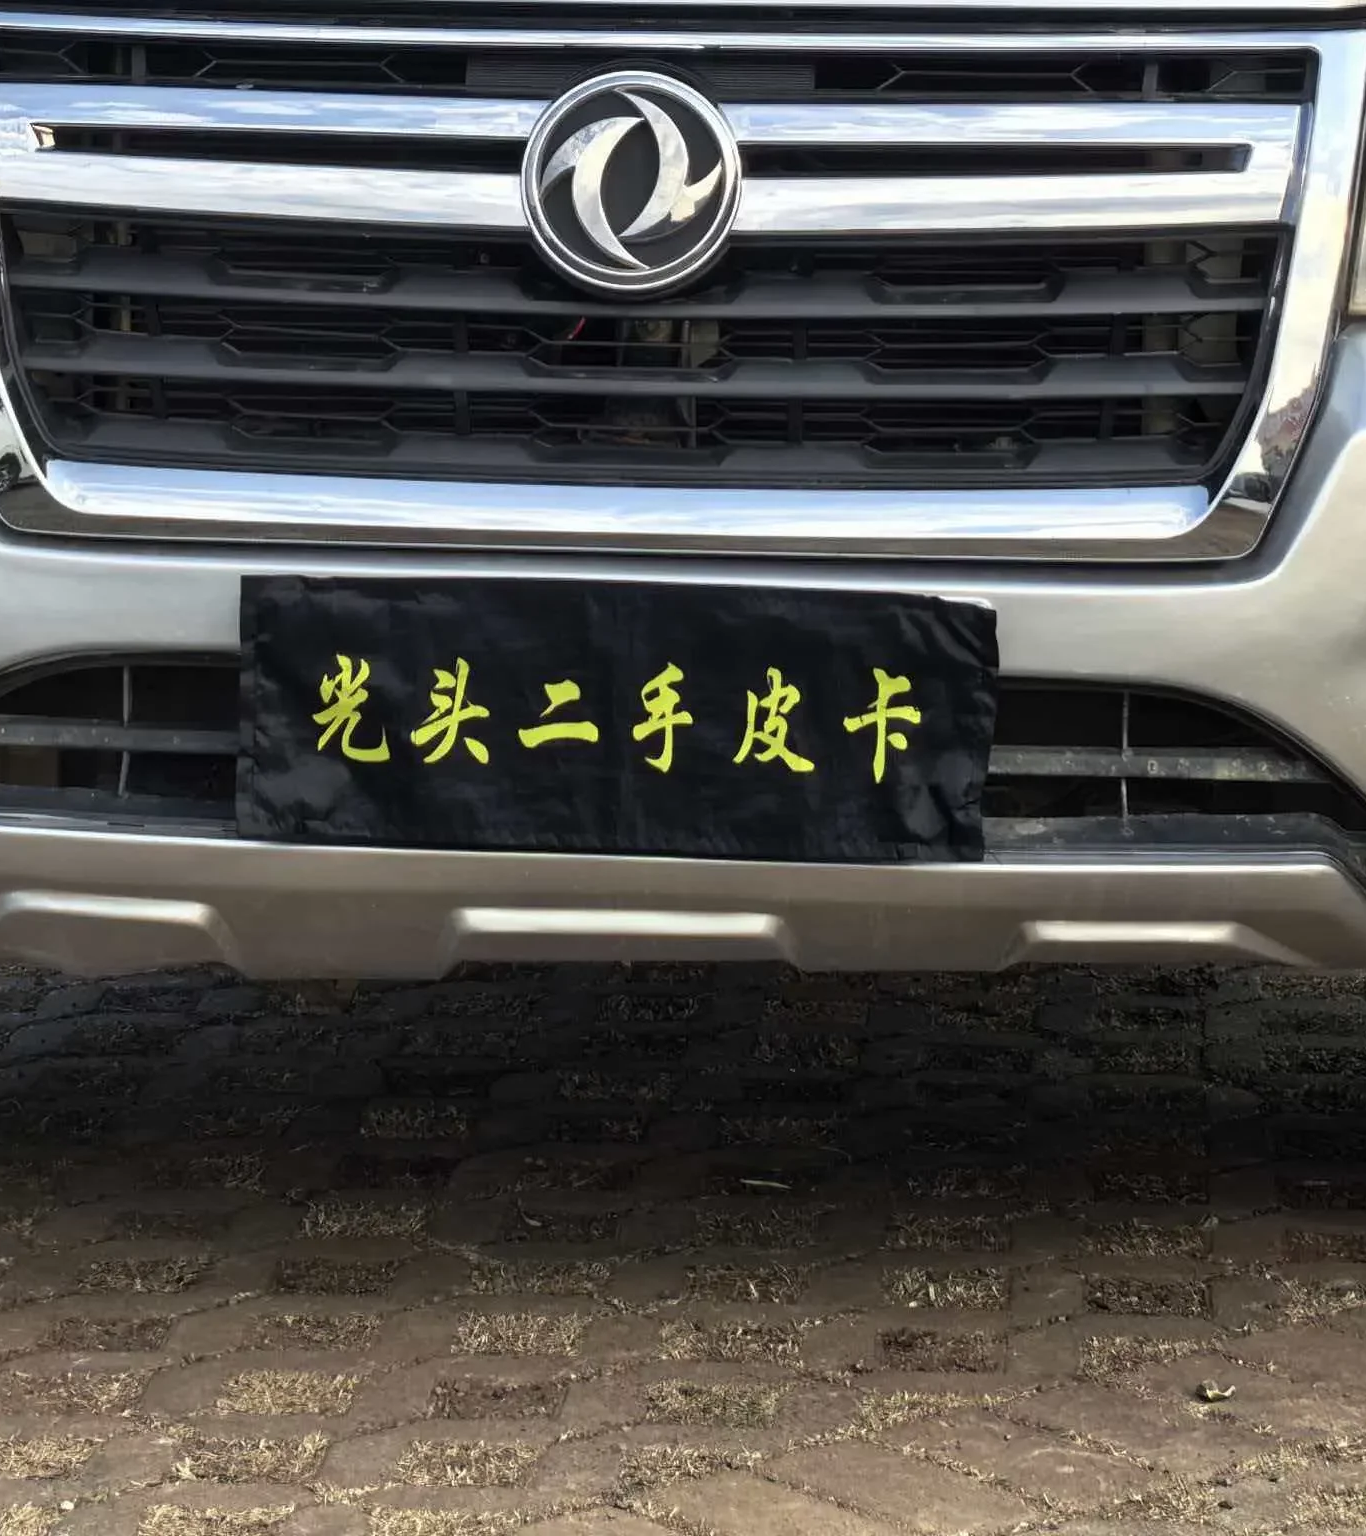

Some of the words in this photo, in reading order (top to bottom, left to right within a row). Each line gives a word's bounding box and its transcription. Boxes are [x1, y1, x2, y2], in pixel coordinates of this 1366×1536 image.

[310, 652, 923, 785] 光头二手皮卡
